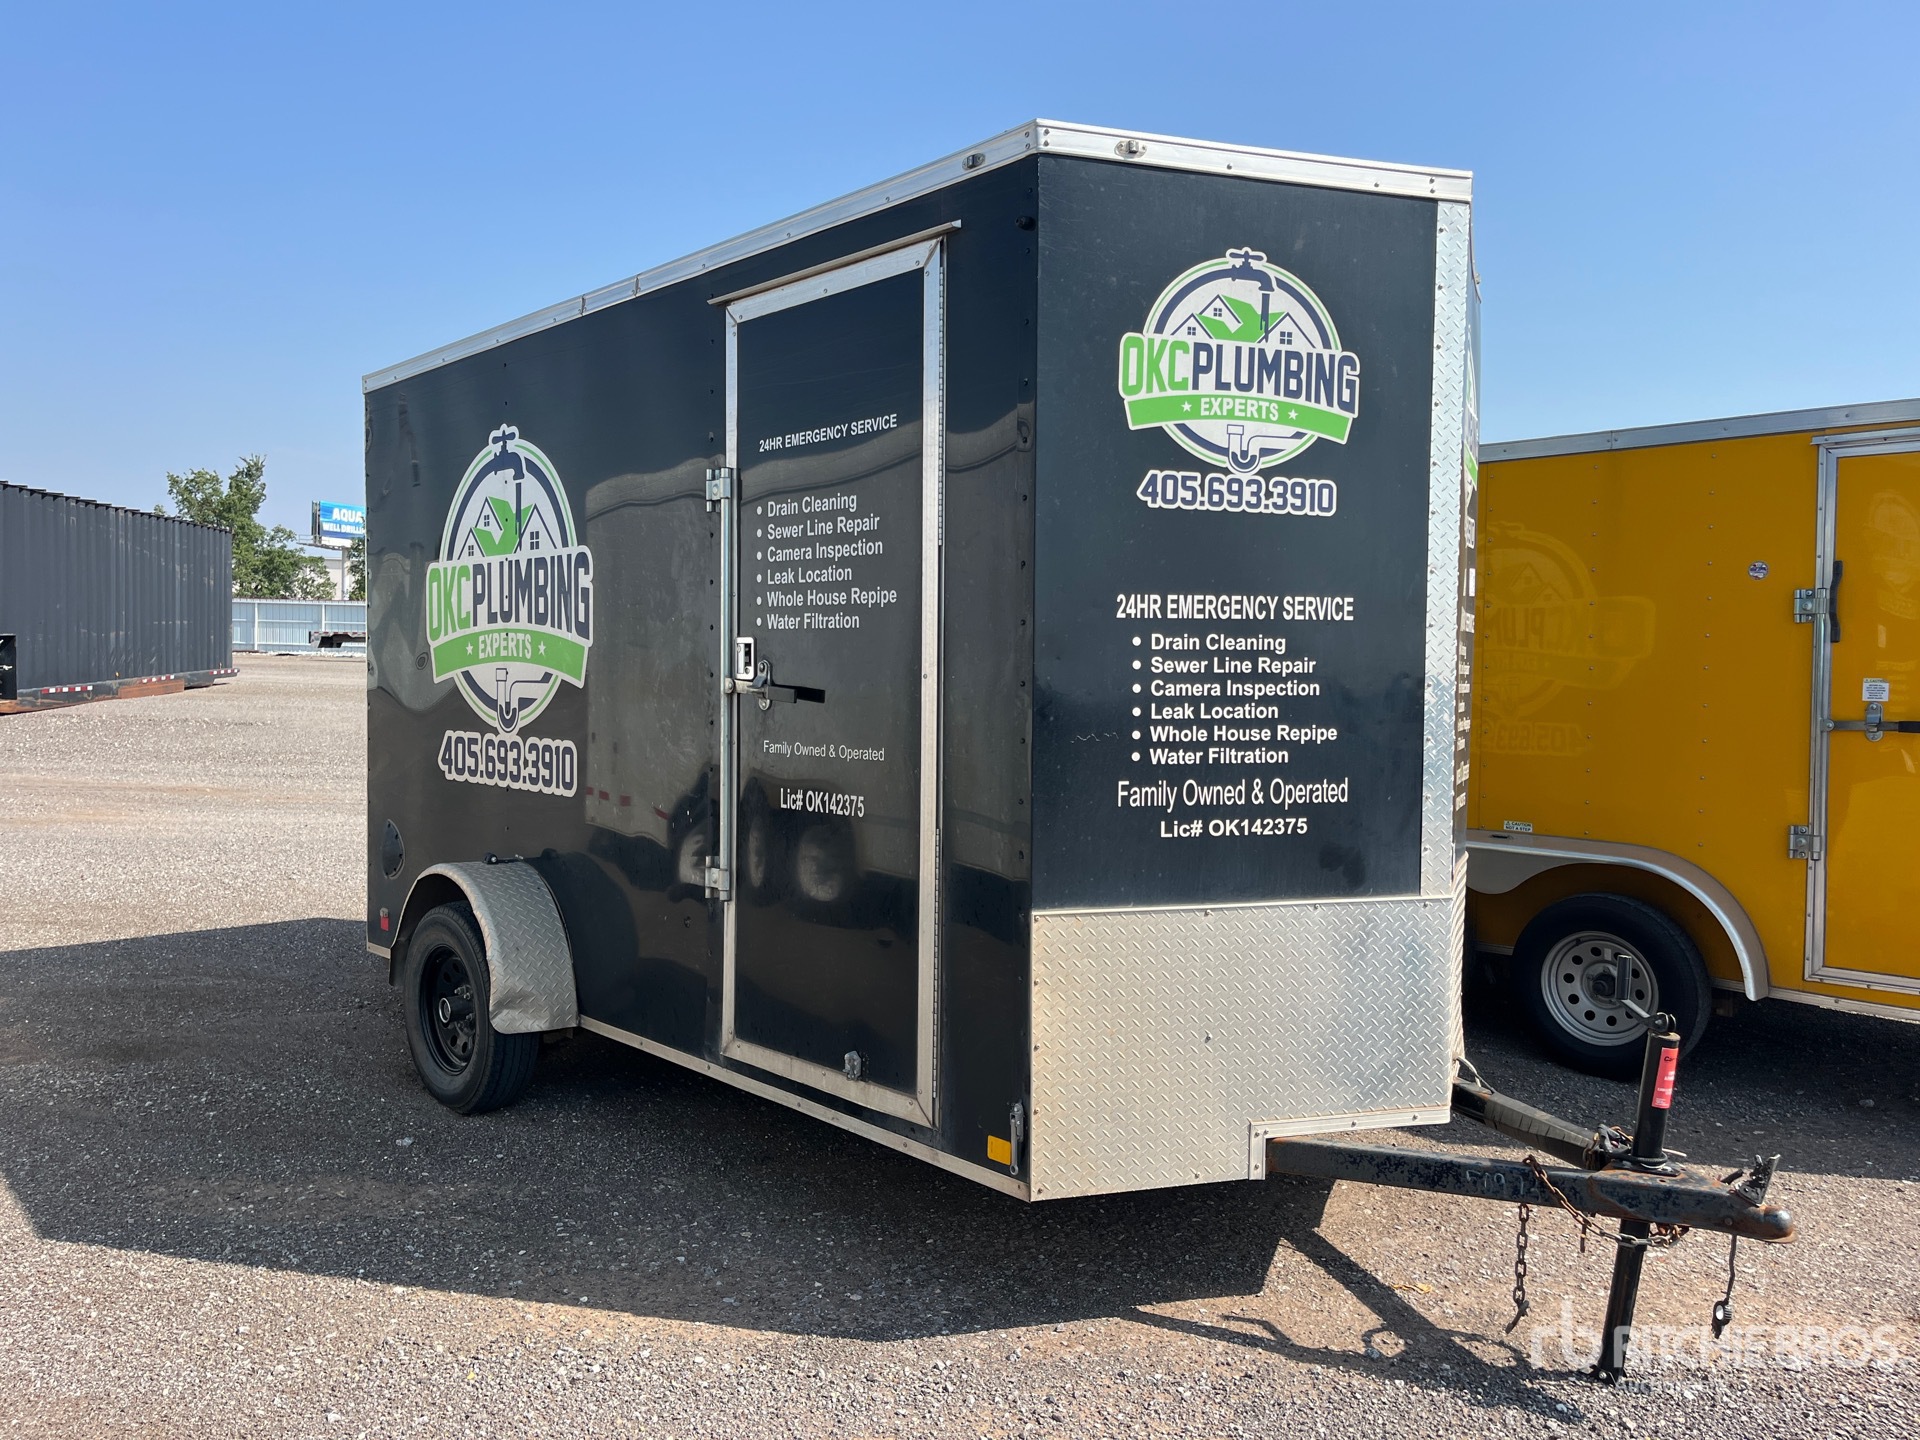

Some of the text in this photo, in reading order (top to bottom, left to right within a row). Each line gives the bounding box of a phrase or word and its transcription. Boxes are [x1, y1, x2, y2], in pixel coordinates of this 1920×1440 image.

[1122, 336, 1357, 413] OKCPLUMBING
[1200, 397, 1279, 422] EXPERTS
[760, 414, 897, 452] 24HR EMERGENCY SERVICE
[1139, 472, 1335, 514] 405.693.3910
[332, 508, 363, 523] AQUA
[768, 493, 856, 517] Drain Cleaning
[322, 522, 340, 531] WELL
[768, 514, 879, 539] Sewer Line Repair
[768, 539, 882, 562] Camera Inspection
[768, 565, 851, 584] Leak Location
[429, 551, 590, 641] OKCPLUMBING
[767, 587, 896, 607] Whole House Repipe
[1117, 594, 1353, 620] 24HR EMERGENCY SERVICE
[767, 612, 859, 629] Water Filtration
[479, 633, 532, 659] EXPERTS
[1152, 634, 1285, 654] Drain Cleaning
[1151, 657, 1316, 677] Sewer Line Repair
[1151, 680, 1319, 699] Camera Inspection
[1152, 703, 1278, 719] Leak Location
[1150, 725, 1337, 744] Whole House Repipe
[764, 740, 884, 761] Family Owned & Operated
[1150, 748, 1288, 764] Water Filtration
[440, 733, 576, 796] 405.693.3910
[781, 788, 864, 817] Lic# OK142375
[1118, 777, 1348, 813] Family Owned & Operated
[1161, 818, 1307, 837] Lic# OK142375
